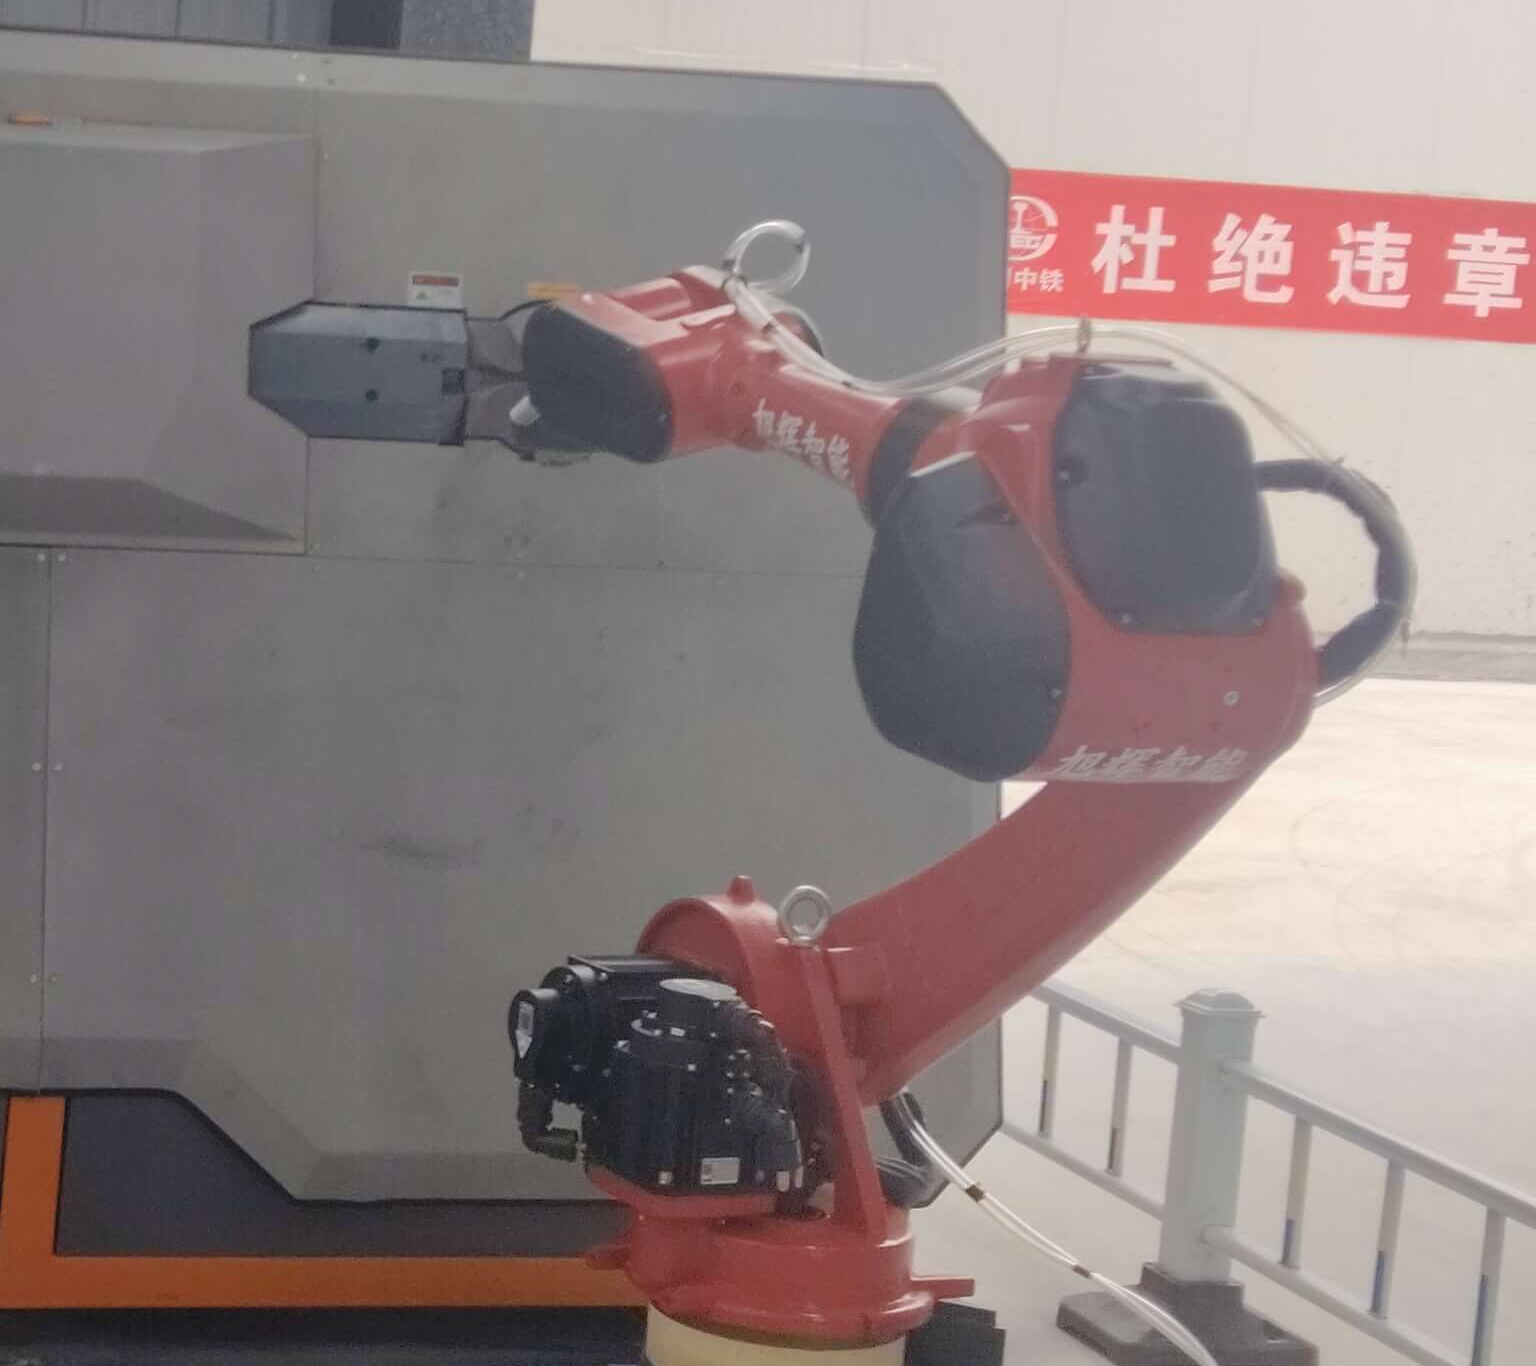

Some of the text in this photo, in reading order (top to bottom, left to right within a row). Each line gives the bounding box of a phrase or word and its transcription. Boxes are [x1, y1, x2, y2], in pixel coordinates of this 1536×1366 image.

[1007, 266, 1064, 292] 中铁
[1090, 204, 1530, 317] 杜绝违章
